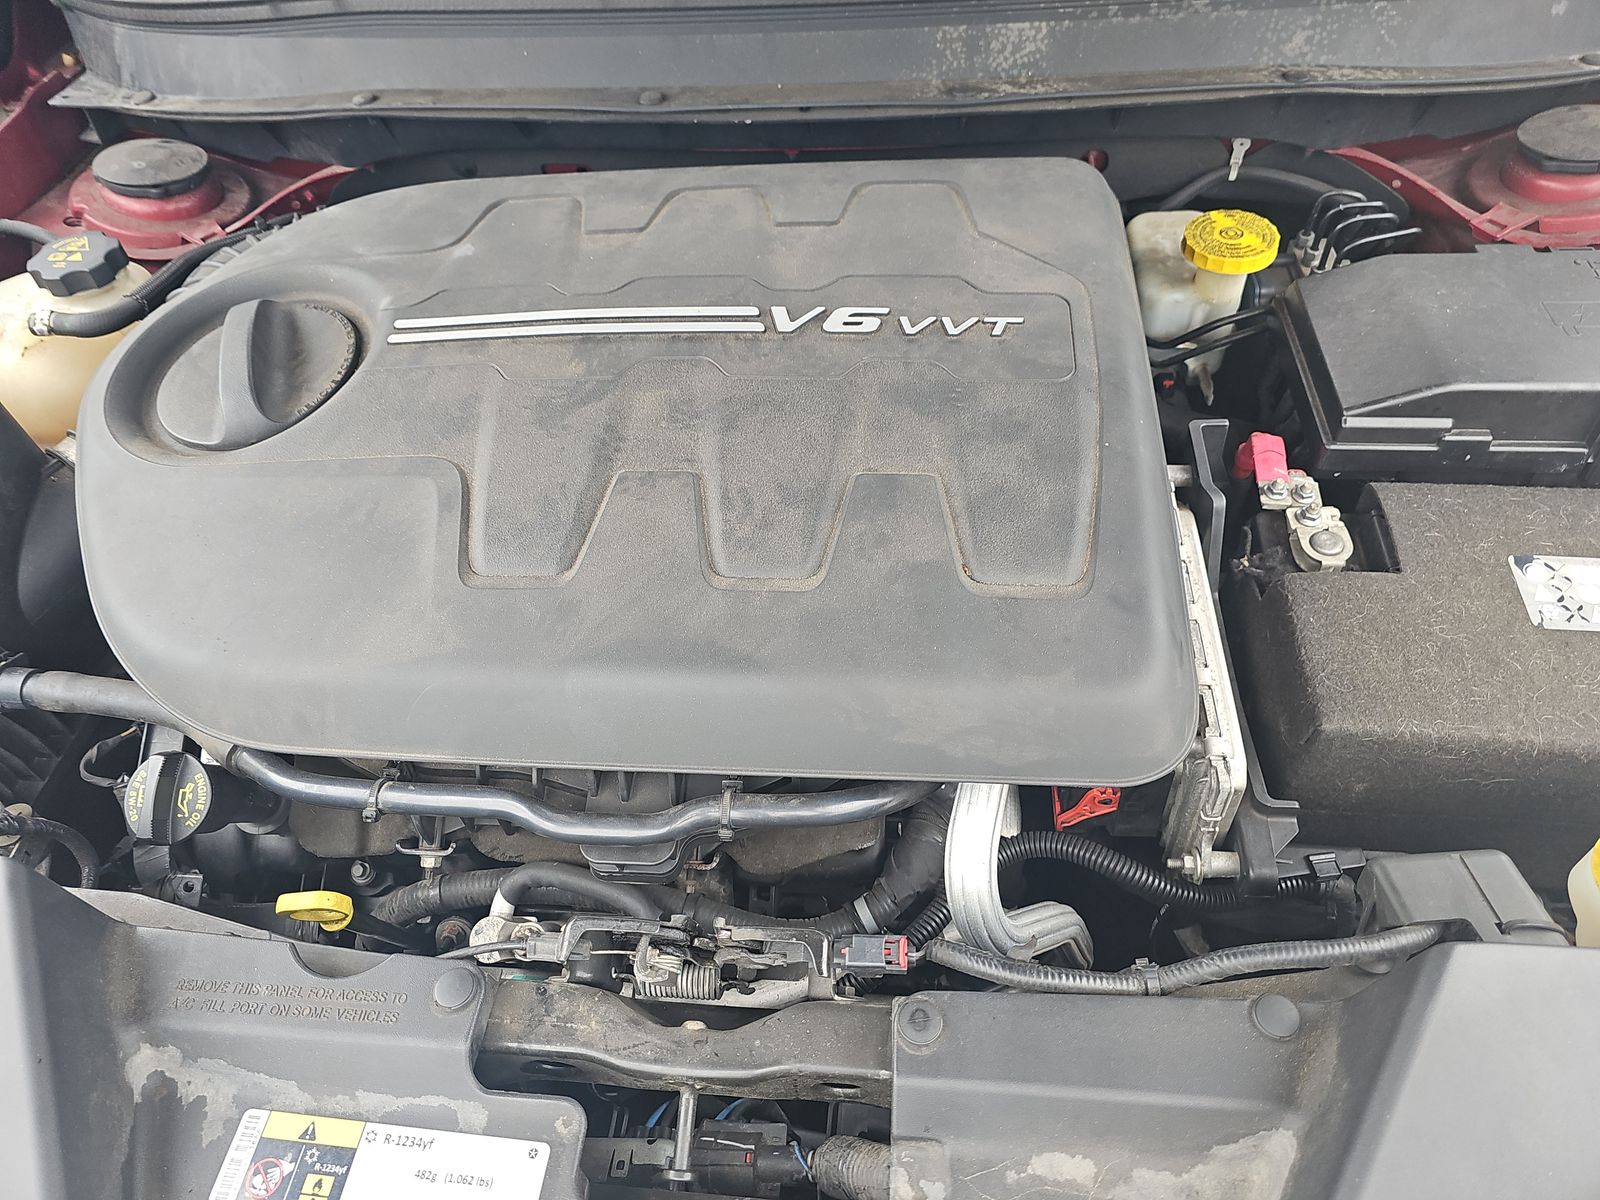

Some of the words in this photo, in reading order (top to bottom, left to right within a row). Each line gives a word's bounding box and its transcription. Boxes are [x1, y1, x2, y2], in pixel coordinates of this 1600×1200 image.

[770, 306, 891, 333] V6
[899, 316, 1025, 336] VVT
[132, 769, 147, 789] SAE
[194, 772, 207, 812] ENGINE
[127, 790, 139, 822] 5W-20
[185, 812, 201, 827] OIL
[176, 978, 231, 994] REMOVE
[231, 981, 261, 996] THIS
[262, 983, 304, 999] PANEL
[307, 985, 335, 1001] FOR
[336, 987, 388, 1003] ACCESS
[390, 991, 408, 1005] TO
[168, 995, 196, 1010] A/C
[199, 997, 226, 1014] FILL
[229, 1000, 267, 1016] PORT
[268, 1002, 290, 1017] ON
[291, 1004, 332, 1020] SOME
[335, 1006, 401, 1024] VEHICLES
[383, 1133, 436, 1151] R-1234yf
[314, 1162, 348, 1176] R-1234yf
[414, 1169, 438, 1183] 482g
[444, 1172, 474, 1187] (1.062
[475, 1176, 494, 1189] lbs)
